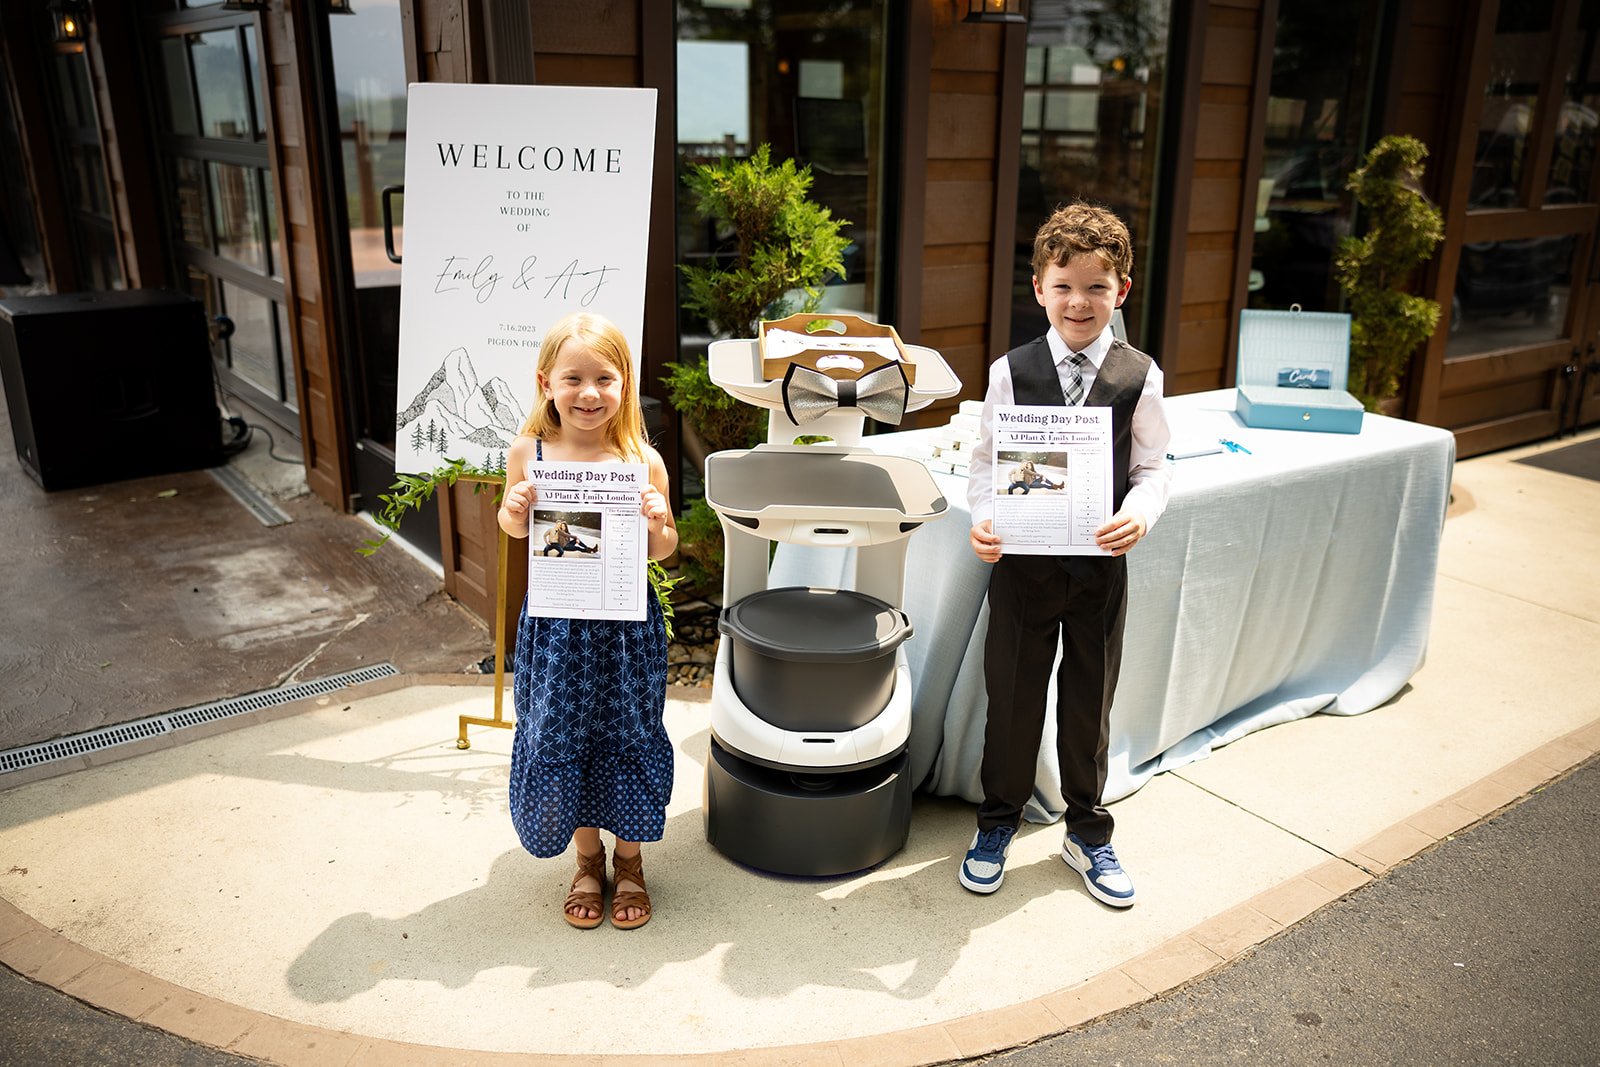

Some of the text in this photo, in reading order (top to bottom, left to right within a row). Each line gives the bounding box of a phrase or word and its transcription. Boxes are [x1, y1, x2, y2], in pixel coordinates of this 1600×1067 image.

[437, 143, 621, 173] WELCOME
[506, 191, 545, 201] TO THE
[499, 206, 550, 217] WEDDING
[517, 223, 531, 232] OF
[434, 255, 504, 304] Emily
[512, 255, 537, 291] &
[499, 323, 536, 333] 7.16.2023
[487, 337, 519, 346] PIGEON
[1288, 369, 1318, 383] Cards
[998, 413, 1100, 426] Wedding Day Post
[533, 470, 636, 483] Wedding Day Post
[554, 492, 572, 500] Platt
[582, 493, 604, 502] Emily
